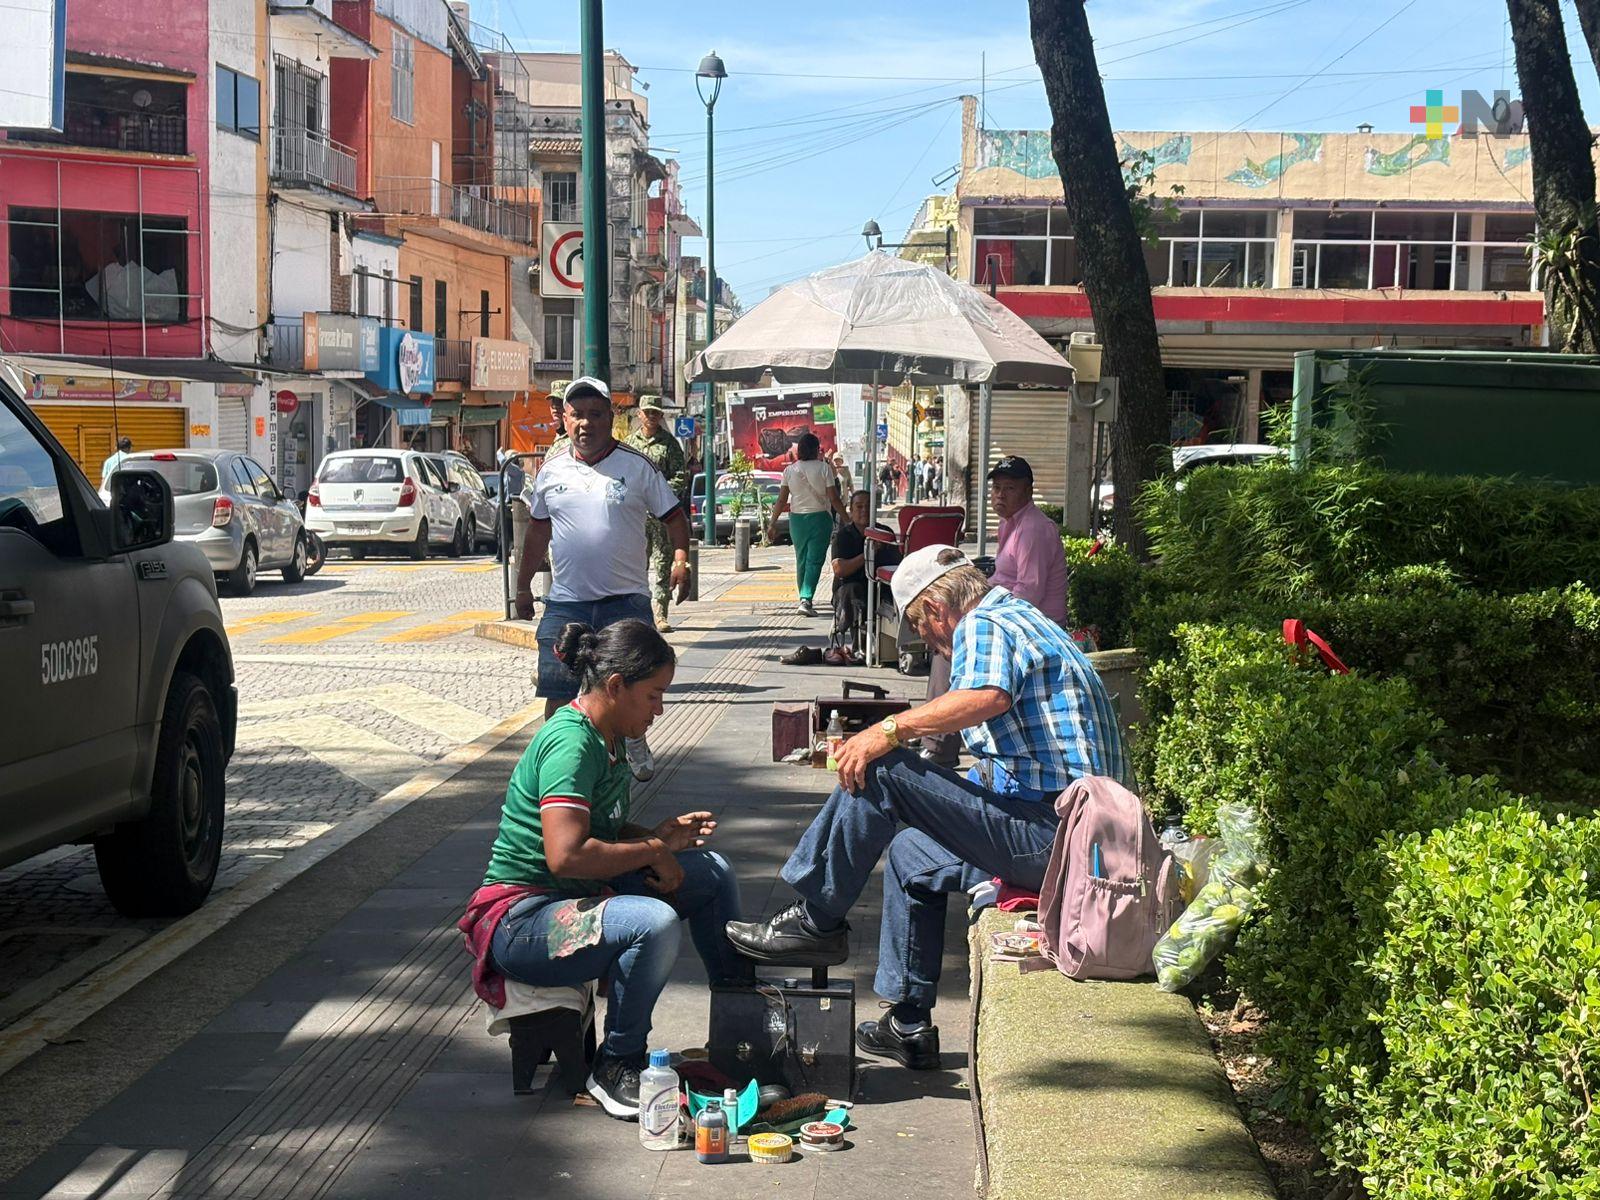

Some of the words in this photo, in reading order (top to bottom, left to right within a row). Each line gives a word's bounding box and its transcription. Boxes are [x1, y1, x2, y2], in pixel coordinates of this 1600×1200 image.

[269, 390, 277, 475] Farmacia
[768, 409, 808, 418] EMPERADOR
[41, 634, 99, 685] 5003995
